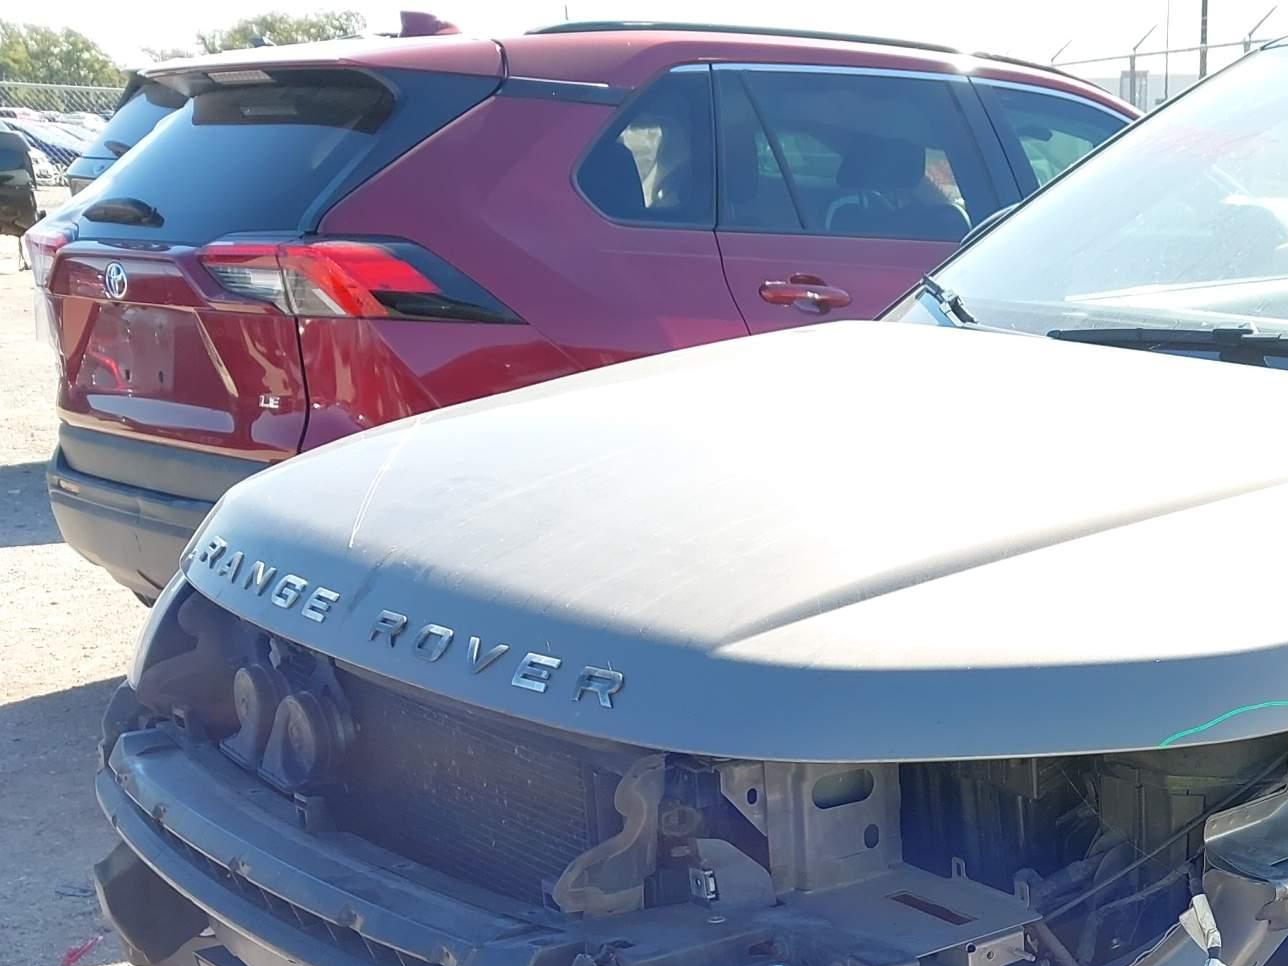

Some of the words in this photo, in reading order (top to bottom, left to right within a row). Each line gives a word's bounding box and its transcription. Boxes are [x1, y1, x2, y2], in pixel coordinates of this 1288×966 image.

[259, 394, 280, 408] LE
[198, 535, 340, 623] RANGE
[368, 608, 625, 708] ROVER
